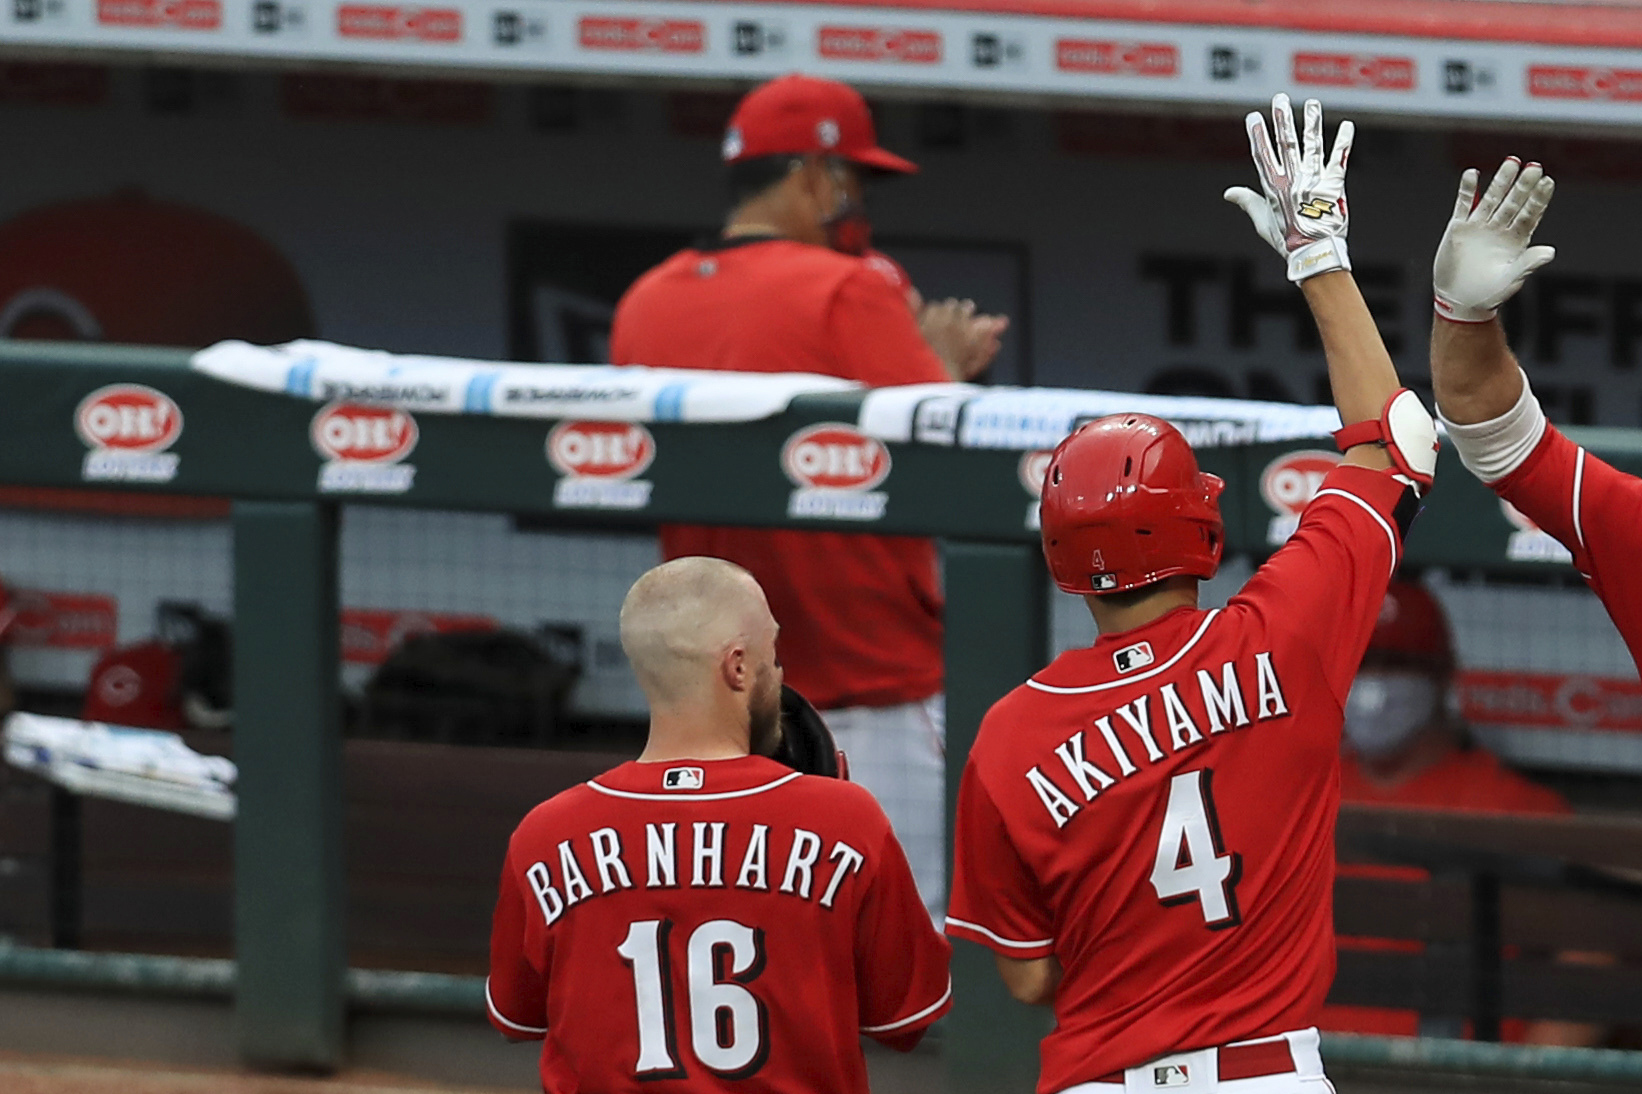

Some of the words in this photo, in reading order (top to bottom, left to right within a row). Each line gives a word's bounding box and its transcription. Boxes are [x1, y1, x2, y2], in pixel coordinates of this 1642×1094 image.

[1092, 549, 1104, 570] 4
[1025, 652, 1290, 829] AKIYAMA
[526, 822, 864, 926] BARNHART
[1150, 768, 1242, 930] 4
[617, 918, 768, 1080] 16
